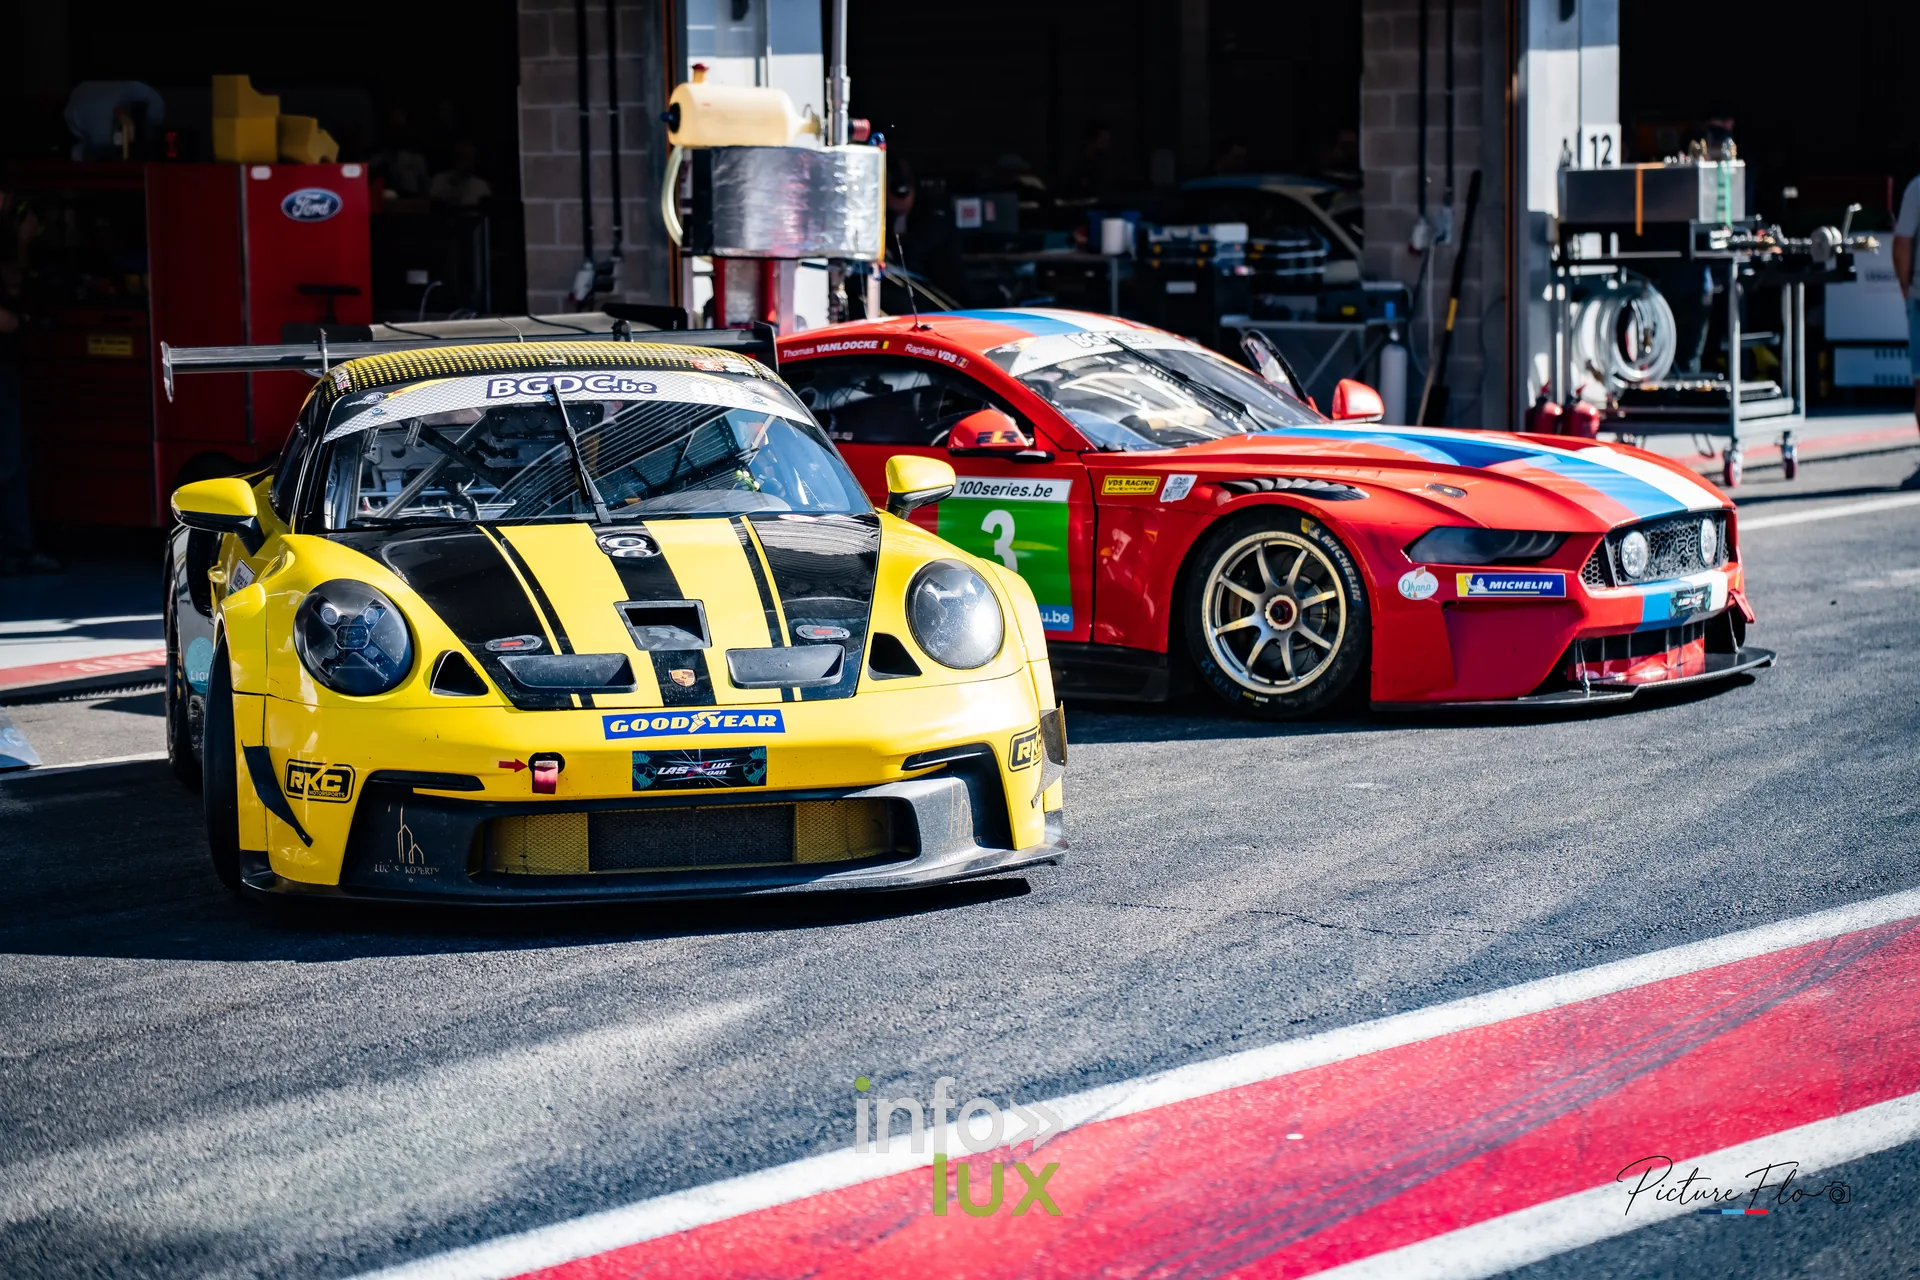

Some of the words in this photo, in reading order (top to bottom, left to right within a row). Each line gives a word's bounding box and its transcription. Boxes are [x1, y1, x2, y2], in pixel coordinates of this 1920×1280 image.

[1591, 134, 1612, 169] 12
[291, 192, 332, 217] Ford
[783, 346, 815, 358] Thomas
[816, 340, 878, 353] VANLOOCKE
[937, 349, 957, 363] VDS
[488, 374, 657, 398] BGDC.be
[958, 481, 1053, 498] 100series.be
[1107, 479, 1123, 487] VDS
[1124, 479, 1155, 487] RACING
[980, 508, 1019, 575] 3
[1320, 534, 1362, 602] MICHELIN
[1401, 579, 1432, 593] Ohana
[1488, 580, 1554, 591] MICHELIN
[1041, 610, 1071, 624] u.be
[289, 765, 343, 793] RKC
